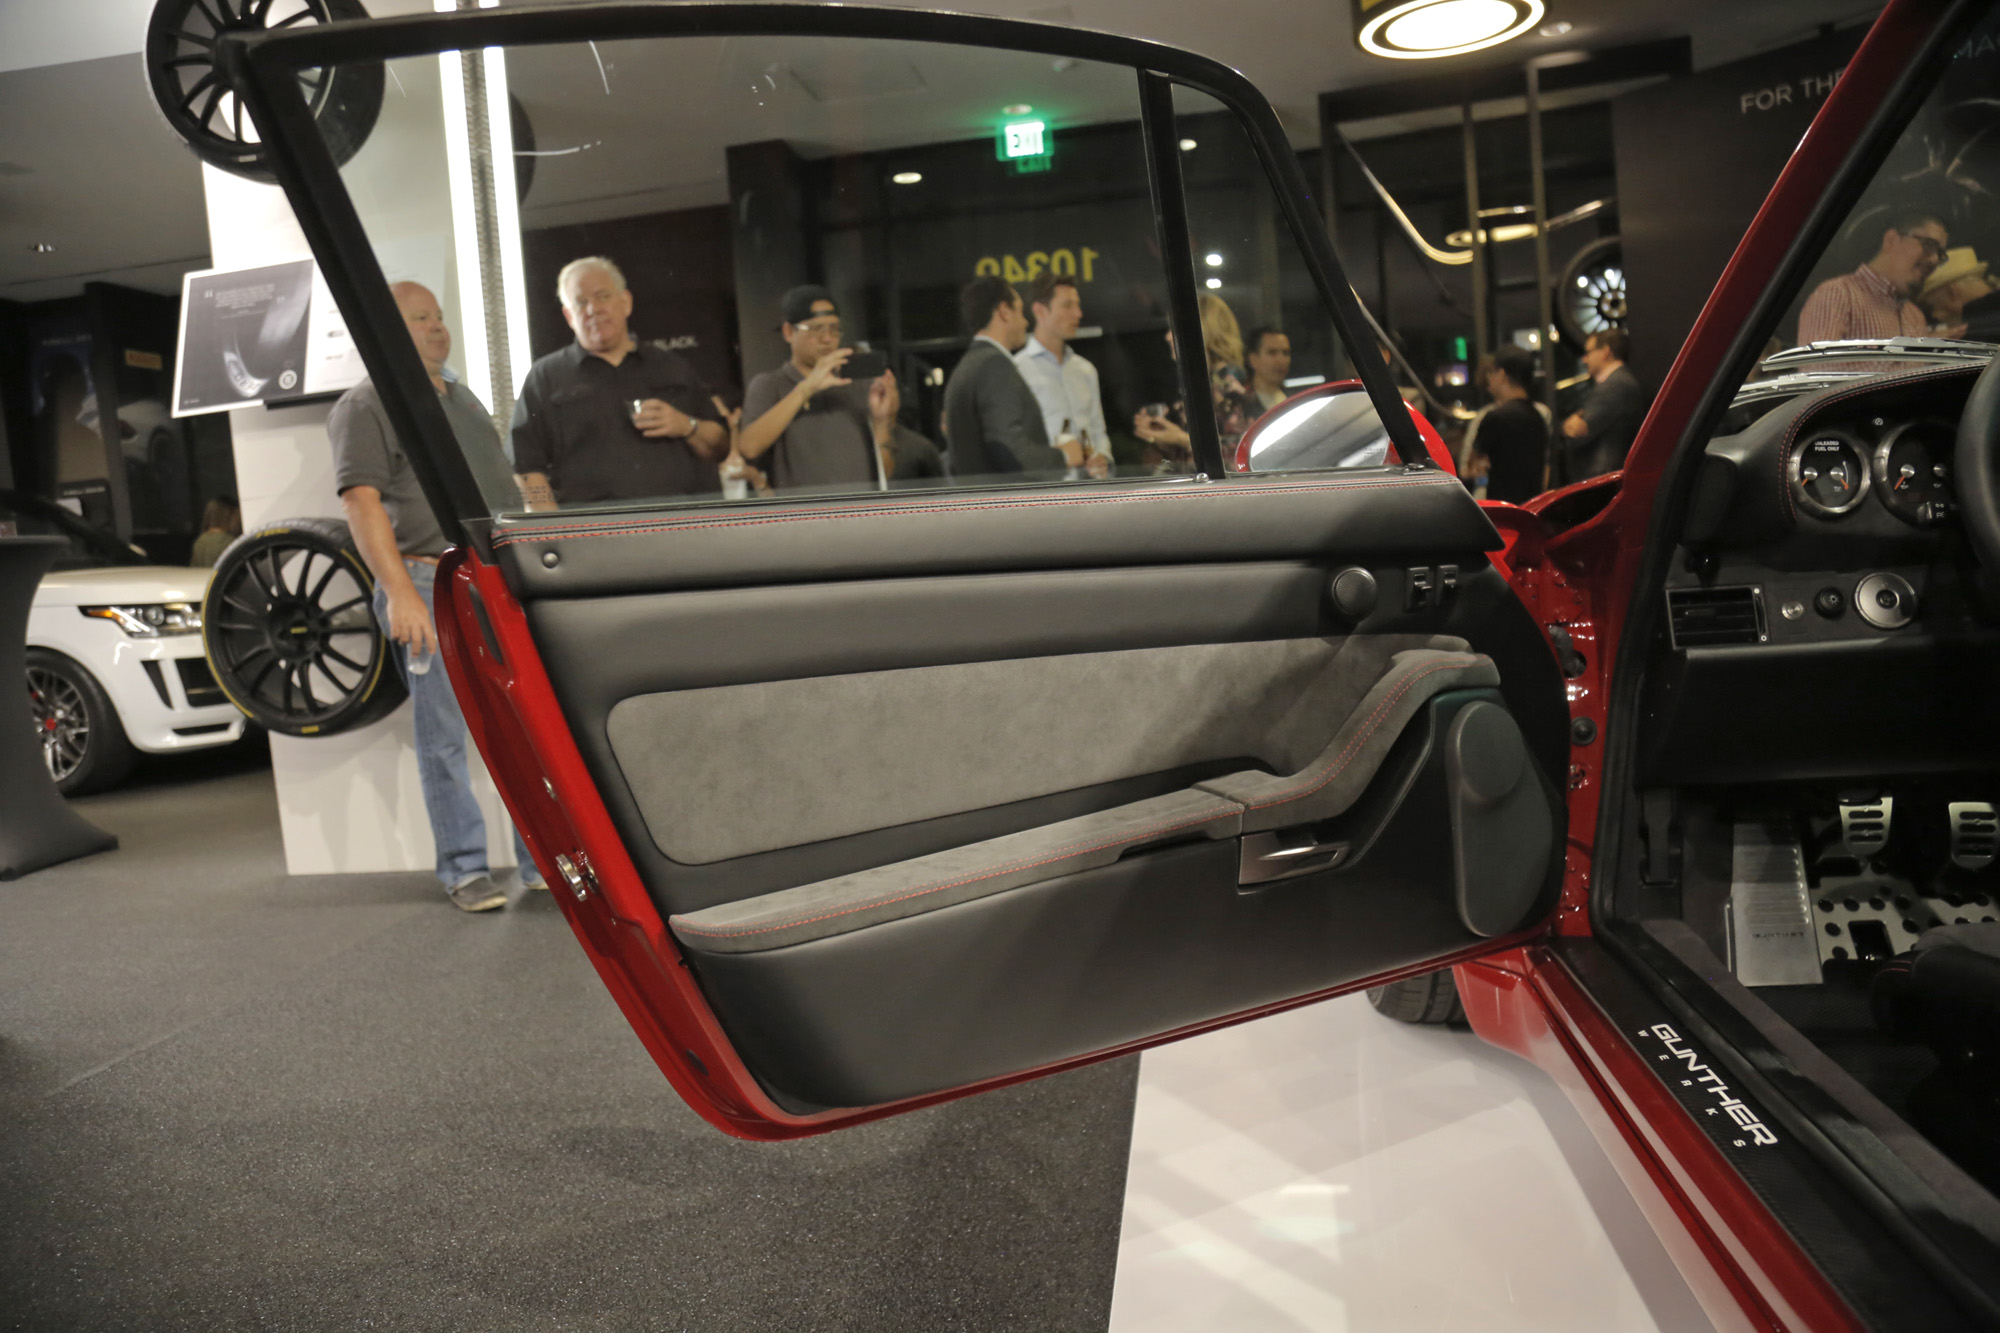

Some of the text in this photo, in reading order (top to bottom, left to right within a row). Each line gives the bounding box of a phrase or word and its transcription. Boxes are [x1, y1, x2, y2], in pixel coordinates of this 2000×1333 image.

[1741, 83, 1792, 114] FOR
[1638, 1030, 1746, 1147] WERKS
[1651, 1023, 1778, 1147] GUNTHER
